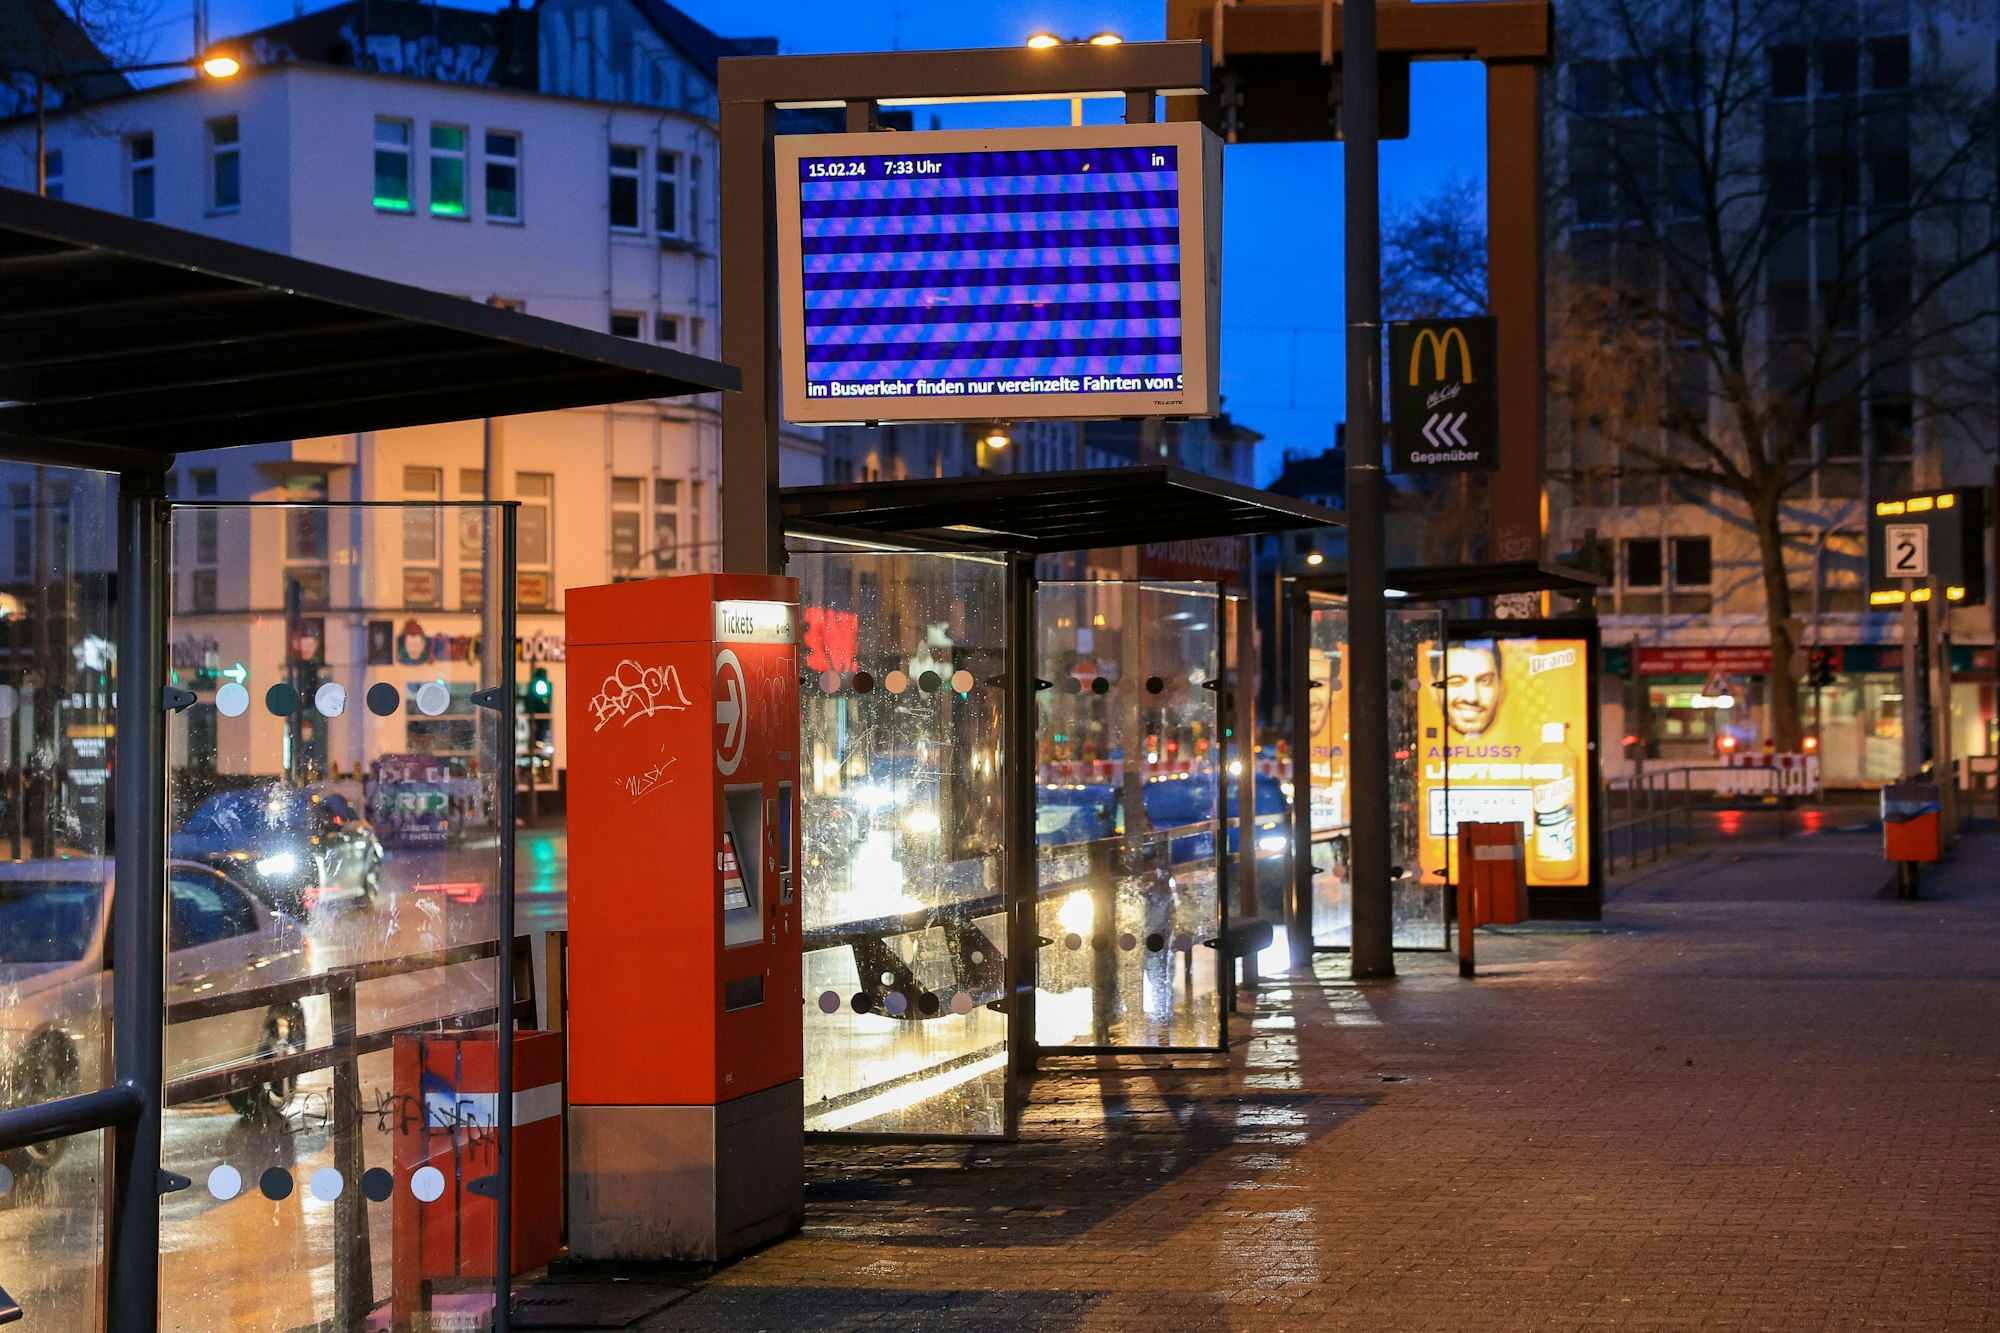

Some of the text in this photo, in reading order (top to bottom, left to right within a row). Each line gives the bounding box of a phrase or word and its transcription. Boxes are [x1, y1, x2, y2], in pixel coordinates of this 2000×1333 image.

[808, 159, 942, 177] 15.02.24 7:33 Uhr
[1151, 152, 1165, 167] in
[808, 382, 828, 397] im
[830, 380, 914, 396] Busverkehr
[916, 378, 964, 394] finden
[967, 381, 995, 394] nur
[997, 376, 1080, 393] vereinzelte
[1083, 375, 1141, 392] Fahrten
[1144, 376, 1174, 390] von
[1410, 450, 1480, 464] Gegenüber
[1897, 542, 1916, 570] 2
[722, 609, 754, 635] Tickets
[1532, 651, 1573, 673] Drano
[1428, 746, 1522, 758] ABFLUSS?
